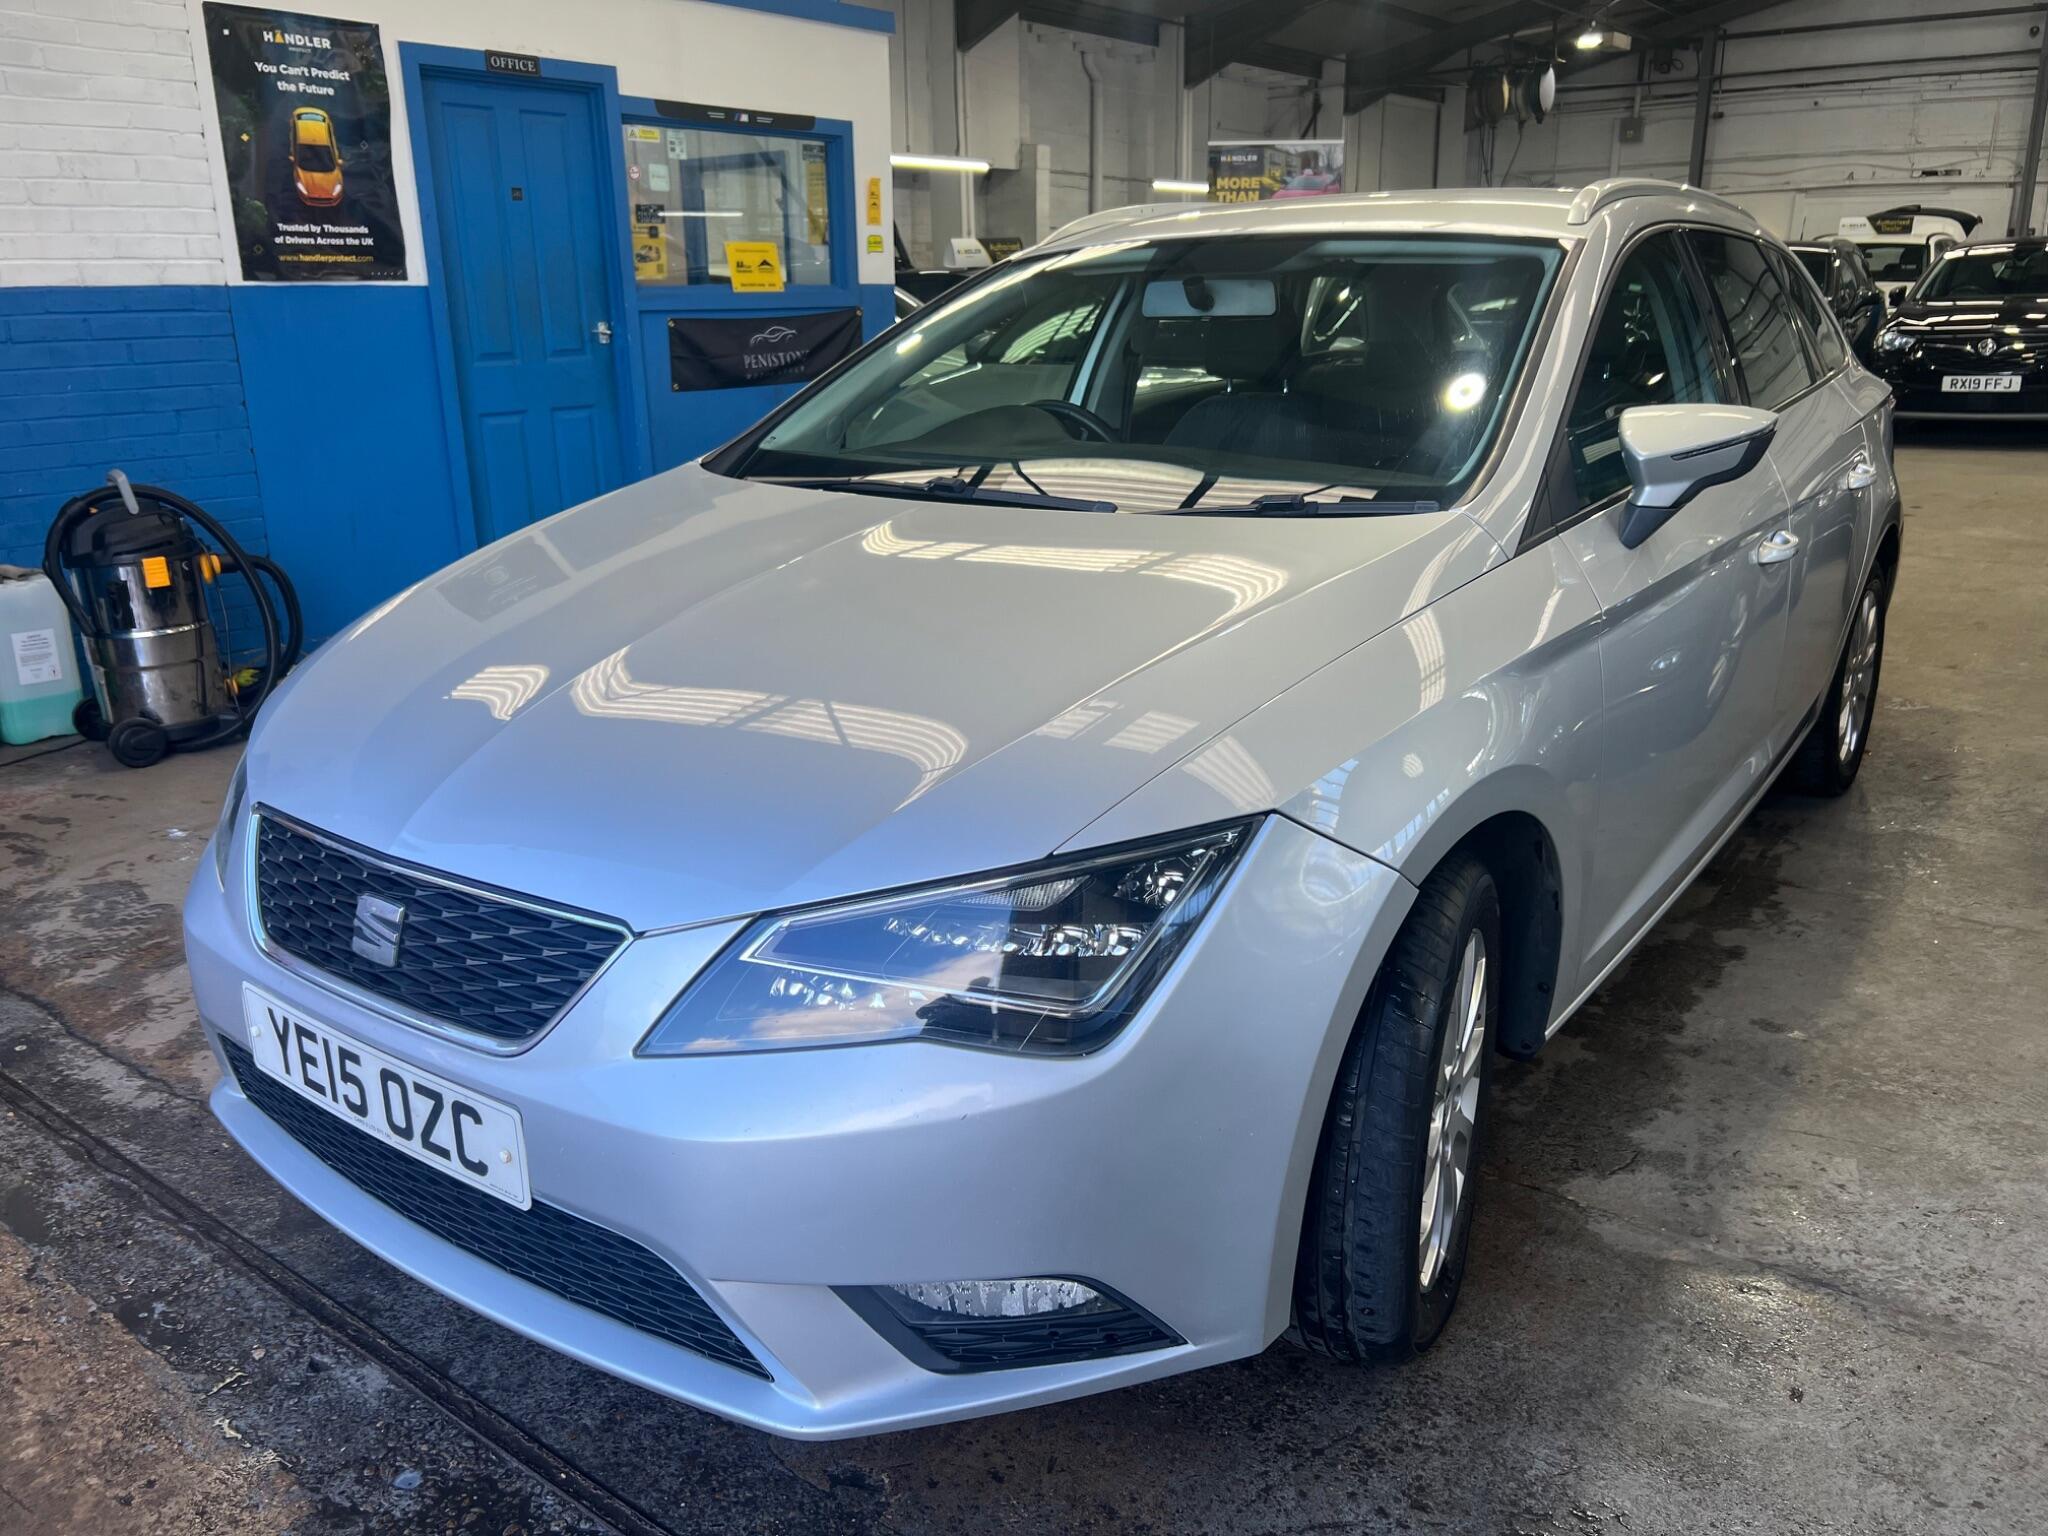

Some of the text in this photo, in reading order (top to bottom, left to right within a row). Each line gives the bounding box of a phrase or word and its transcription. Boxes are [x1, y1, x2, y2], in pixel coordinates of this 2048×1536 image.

[263, 30, 331, 49] HANDLER
[490, 55, 536, 71] OFFICE
[254, 61, 351, 81] You Can't Predict
[277, 81, 335, 96] the Future
[1216, 177, 1260, 189] MORE
[1216, 191, 1259, 203] THAN
[277, 223, 369, 234] Trusted by Thousands
[274, 236, 374, 246] of Drivers Across the UK
[278, 253, 374, 263] www.handlerprotect.com
[743, 350, 810, 369] PENISTON
[1950, 378, 2013, 390] RX19 FFJ
[267, 1006, 489, 1178] YE15 OZC
